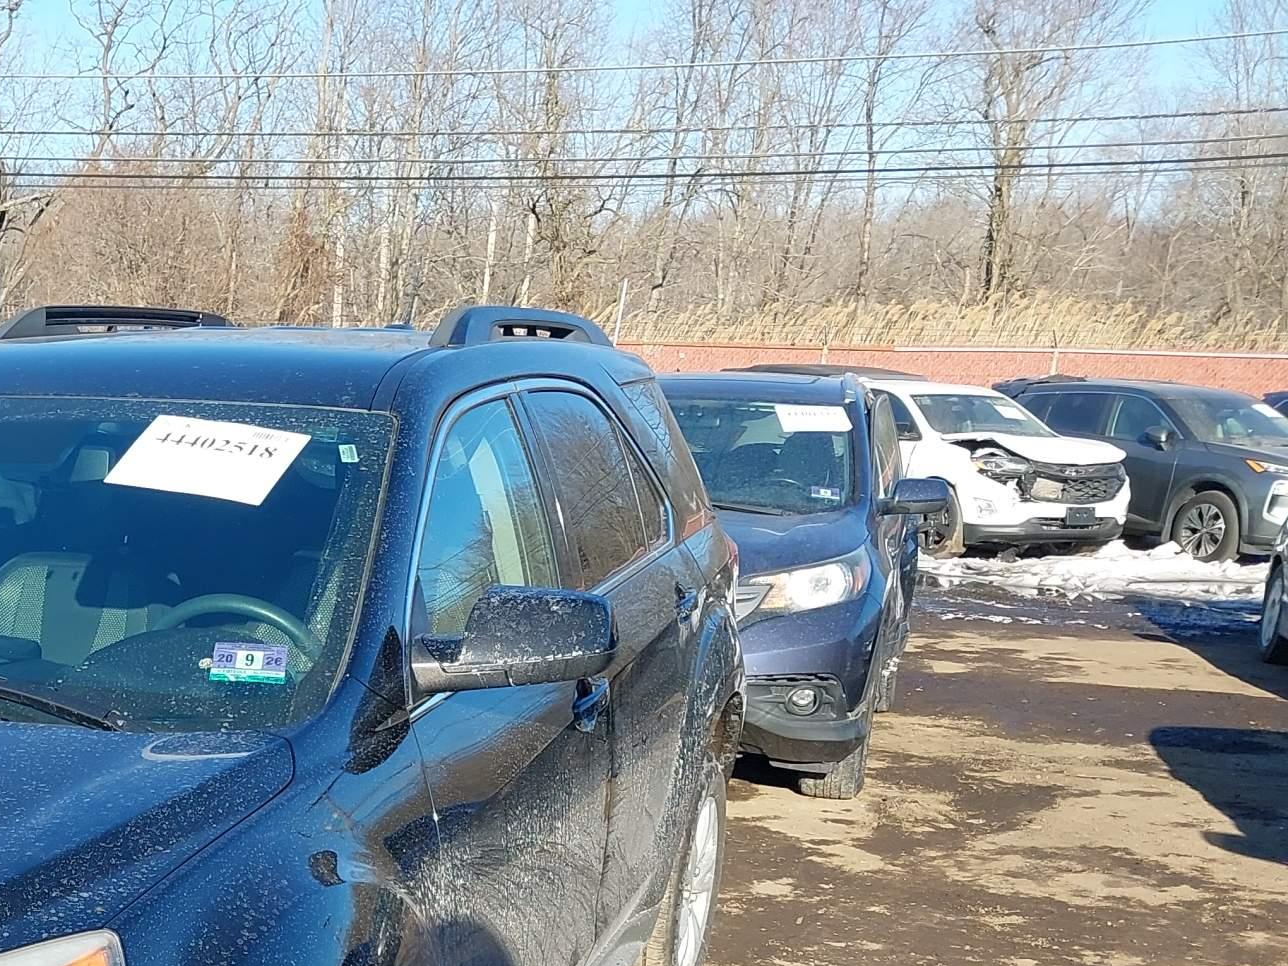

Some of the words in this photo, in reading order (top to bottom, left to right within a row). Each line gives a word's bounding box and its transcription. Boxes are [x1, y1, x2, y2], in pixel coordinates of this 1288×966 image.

[155, 431, 279, 459] 44402518
[217, 653, 234, 664] 20
[244, 652, 255, 667] 9
